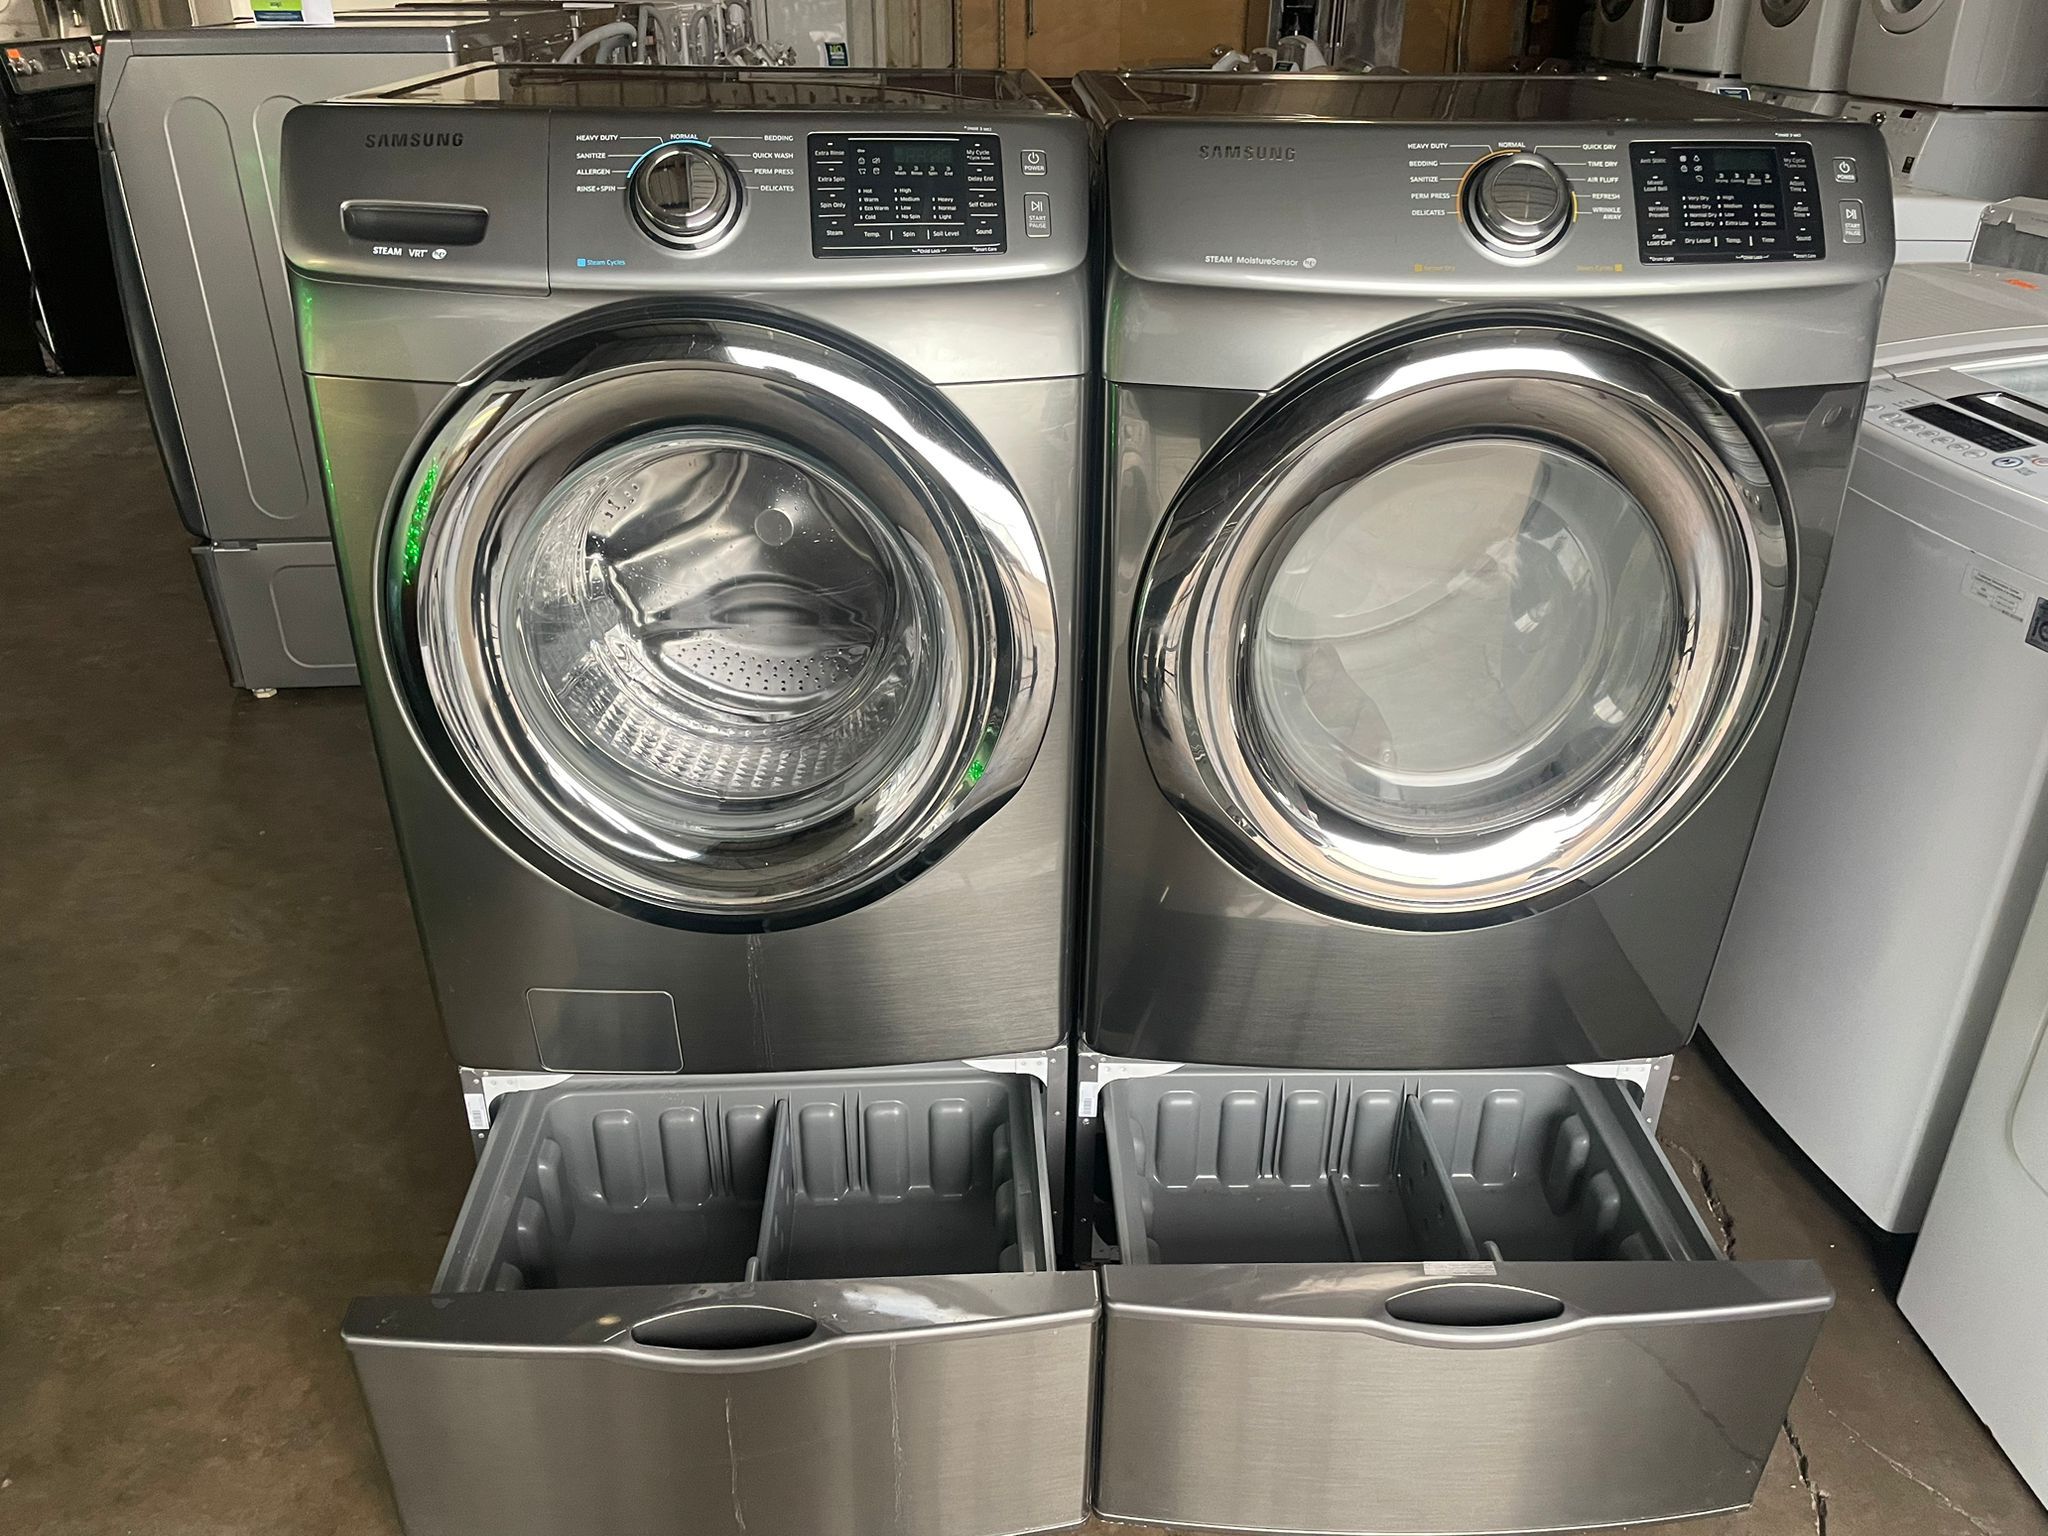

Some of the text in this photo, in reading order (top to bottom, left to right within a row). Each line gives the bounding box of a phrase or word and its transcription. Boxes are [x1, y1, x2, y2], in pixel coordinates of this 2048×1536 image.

[365, 133, 464, 148] SAMSUNG
[1199, 145, 1296, 162] SAMSUNG
[372, 247, 402, 256] STEAM
[1205, 255, 1233, 263] STEAM
[1237, 256, 1299, 266] MoistureSensor
